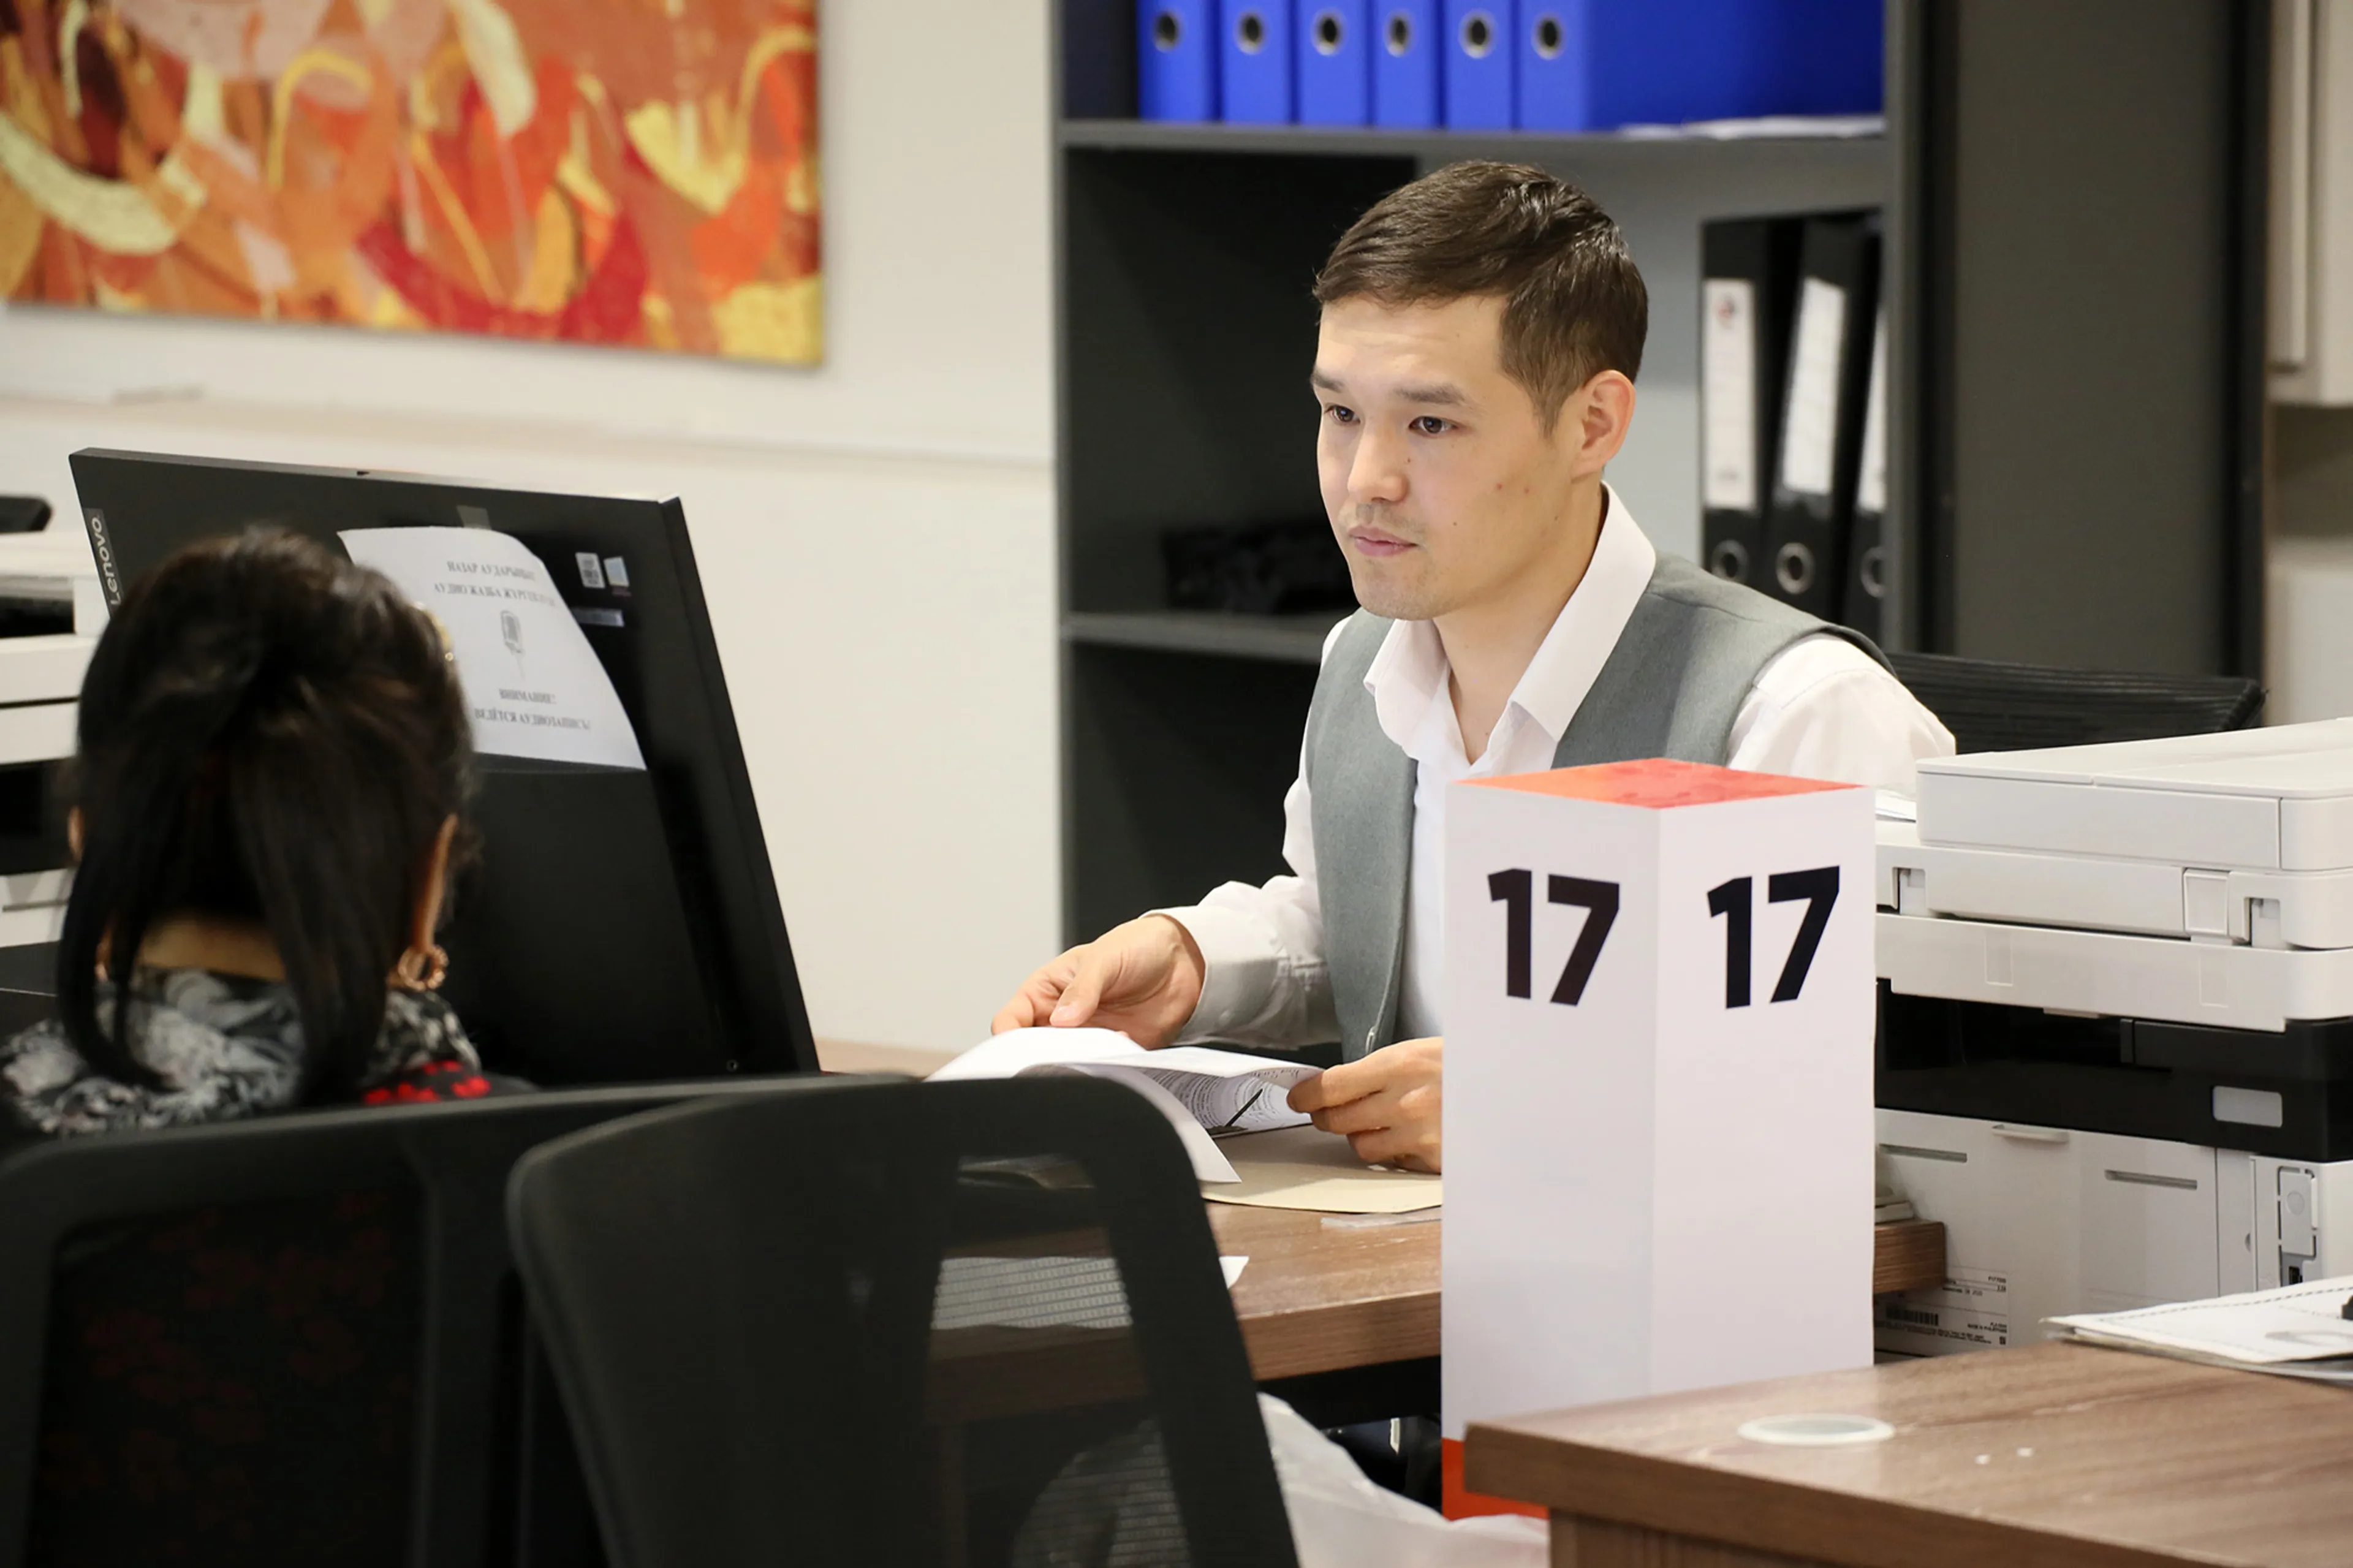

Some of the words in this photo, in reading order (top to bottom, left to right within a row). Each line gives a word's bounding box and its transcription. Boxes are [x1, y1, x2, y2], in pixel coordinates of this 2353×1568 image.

[92, 517, 121, 605] Lenovo
[1487, 868, 1620, 1007] 17
[1707, 865, 1840, 1009] 17
